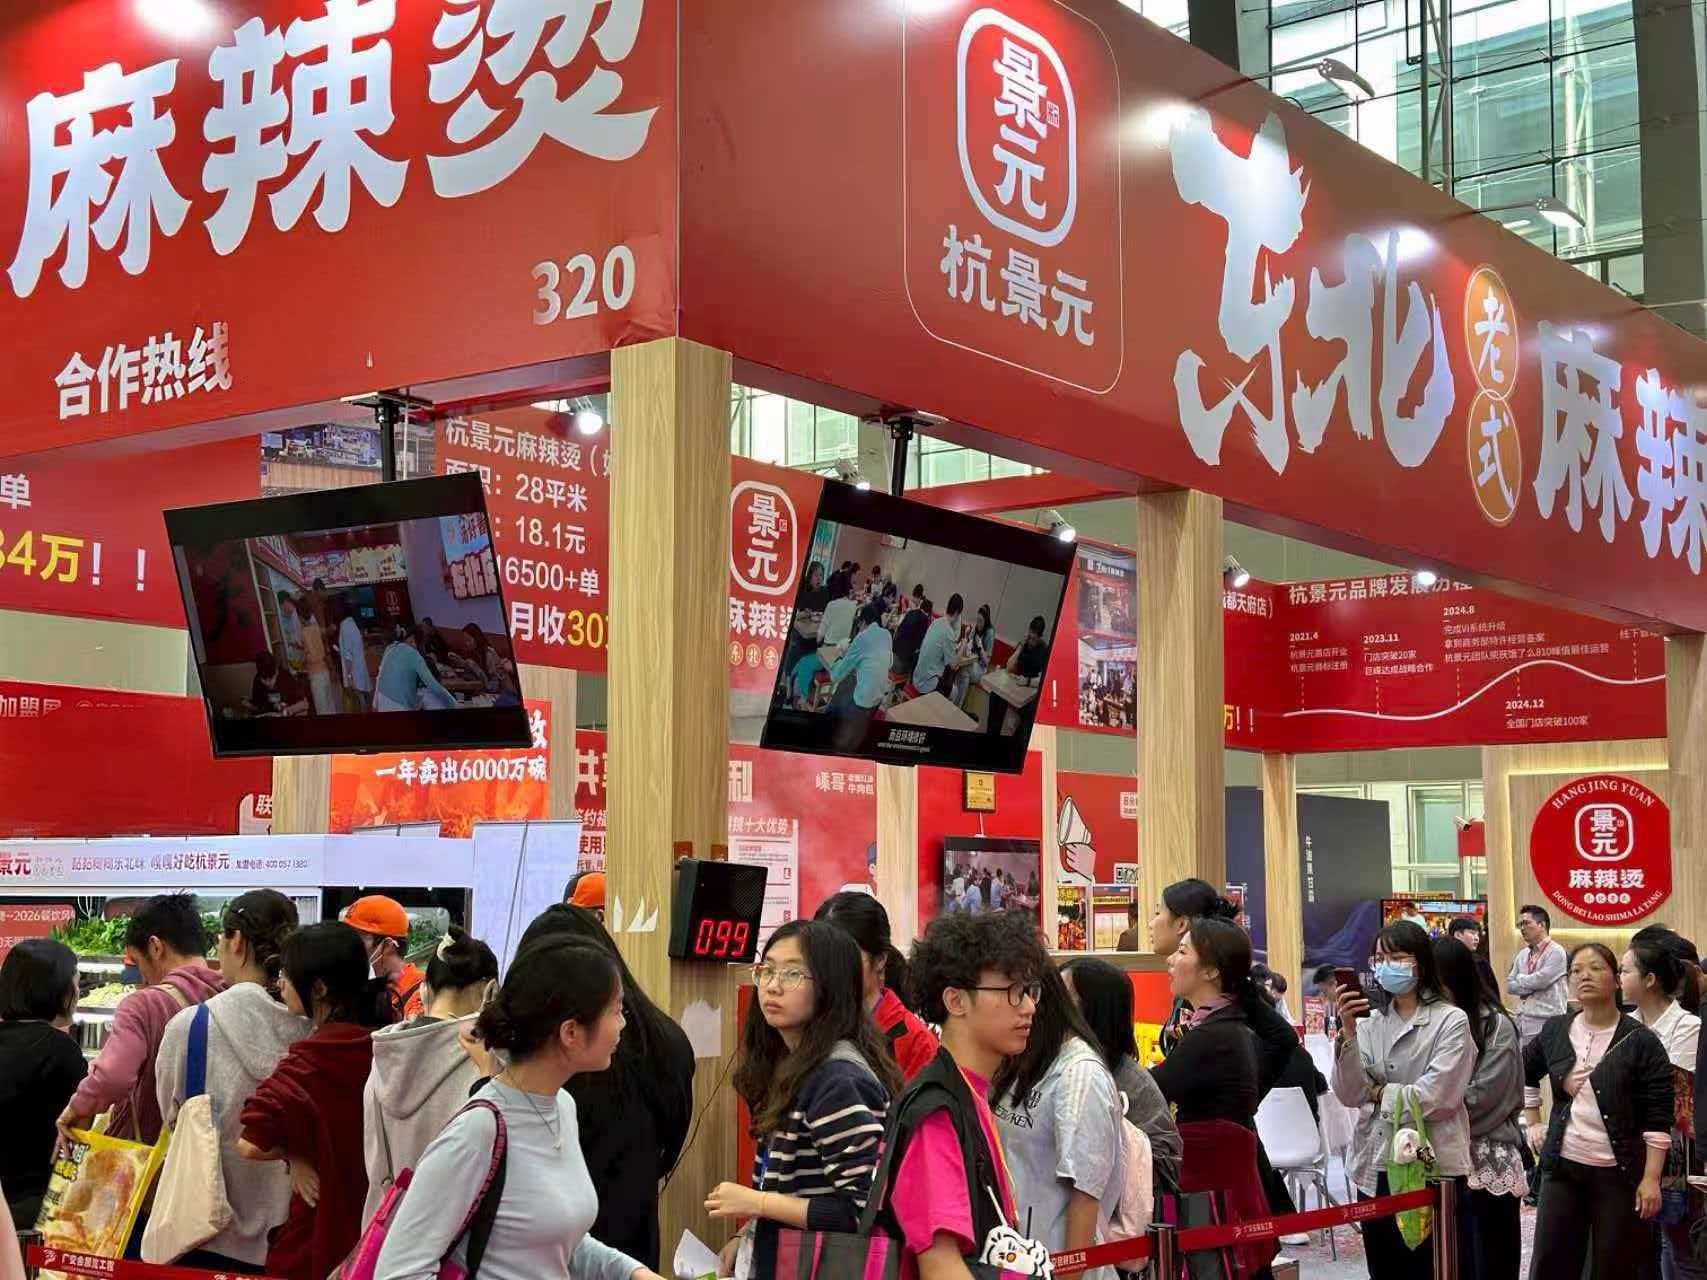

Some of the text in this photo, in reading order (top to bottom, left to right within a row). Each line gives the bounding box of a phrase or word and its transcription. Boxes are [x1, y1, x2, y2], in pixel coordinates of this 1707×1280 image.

[992, 36, 1047, 220] 景元
[6, 0, 660, 299] 麻辣烫
[532, 244, 634, 325] 320
[940, 223, 1095, 347] 杭景元
[1168, 105, 1454, 476] 东北
[1472, 287, 1516, 510] 老式
[55, 321, 234, 420] 合作热线
[746, 493, 783, 583] 景元
[510, 601, 609, 649] 月收30
[1443, 605, 1475, 616] 2024.8
[1289, 632, 1319, 642] 2021.4
[1363, 633, 1399, 644] 2023.11
[1505, 699, 1545, 710] 2024.12
[375, 755, 548, 785] 一年卖出6000万碗
[1552, 780, 1655, 809] HANG JING YUAN
[1590, 809, 1618, 854] 景元
[1568, 868, 1645, 889] 麻辣烫
[1552, 890, 1573, 910] DONG
[1573, 906, 1587, 917] BEI
[1588, 911, 1604, 921] LAO
[696, 919, 749, 956] 099
